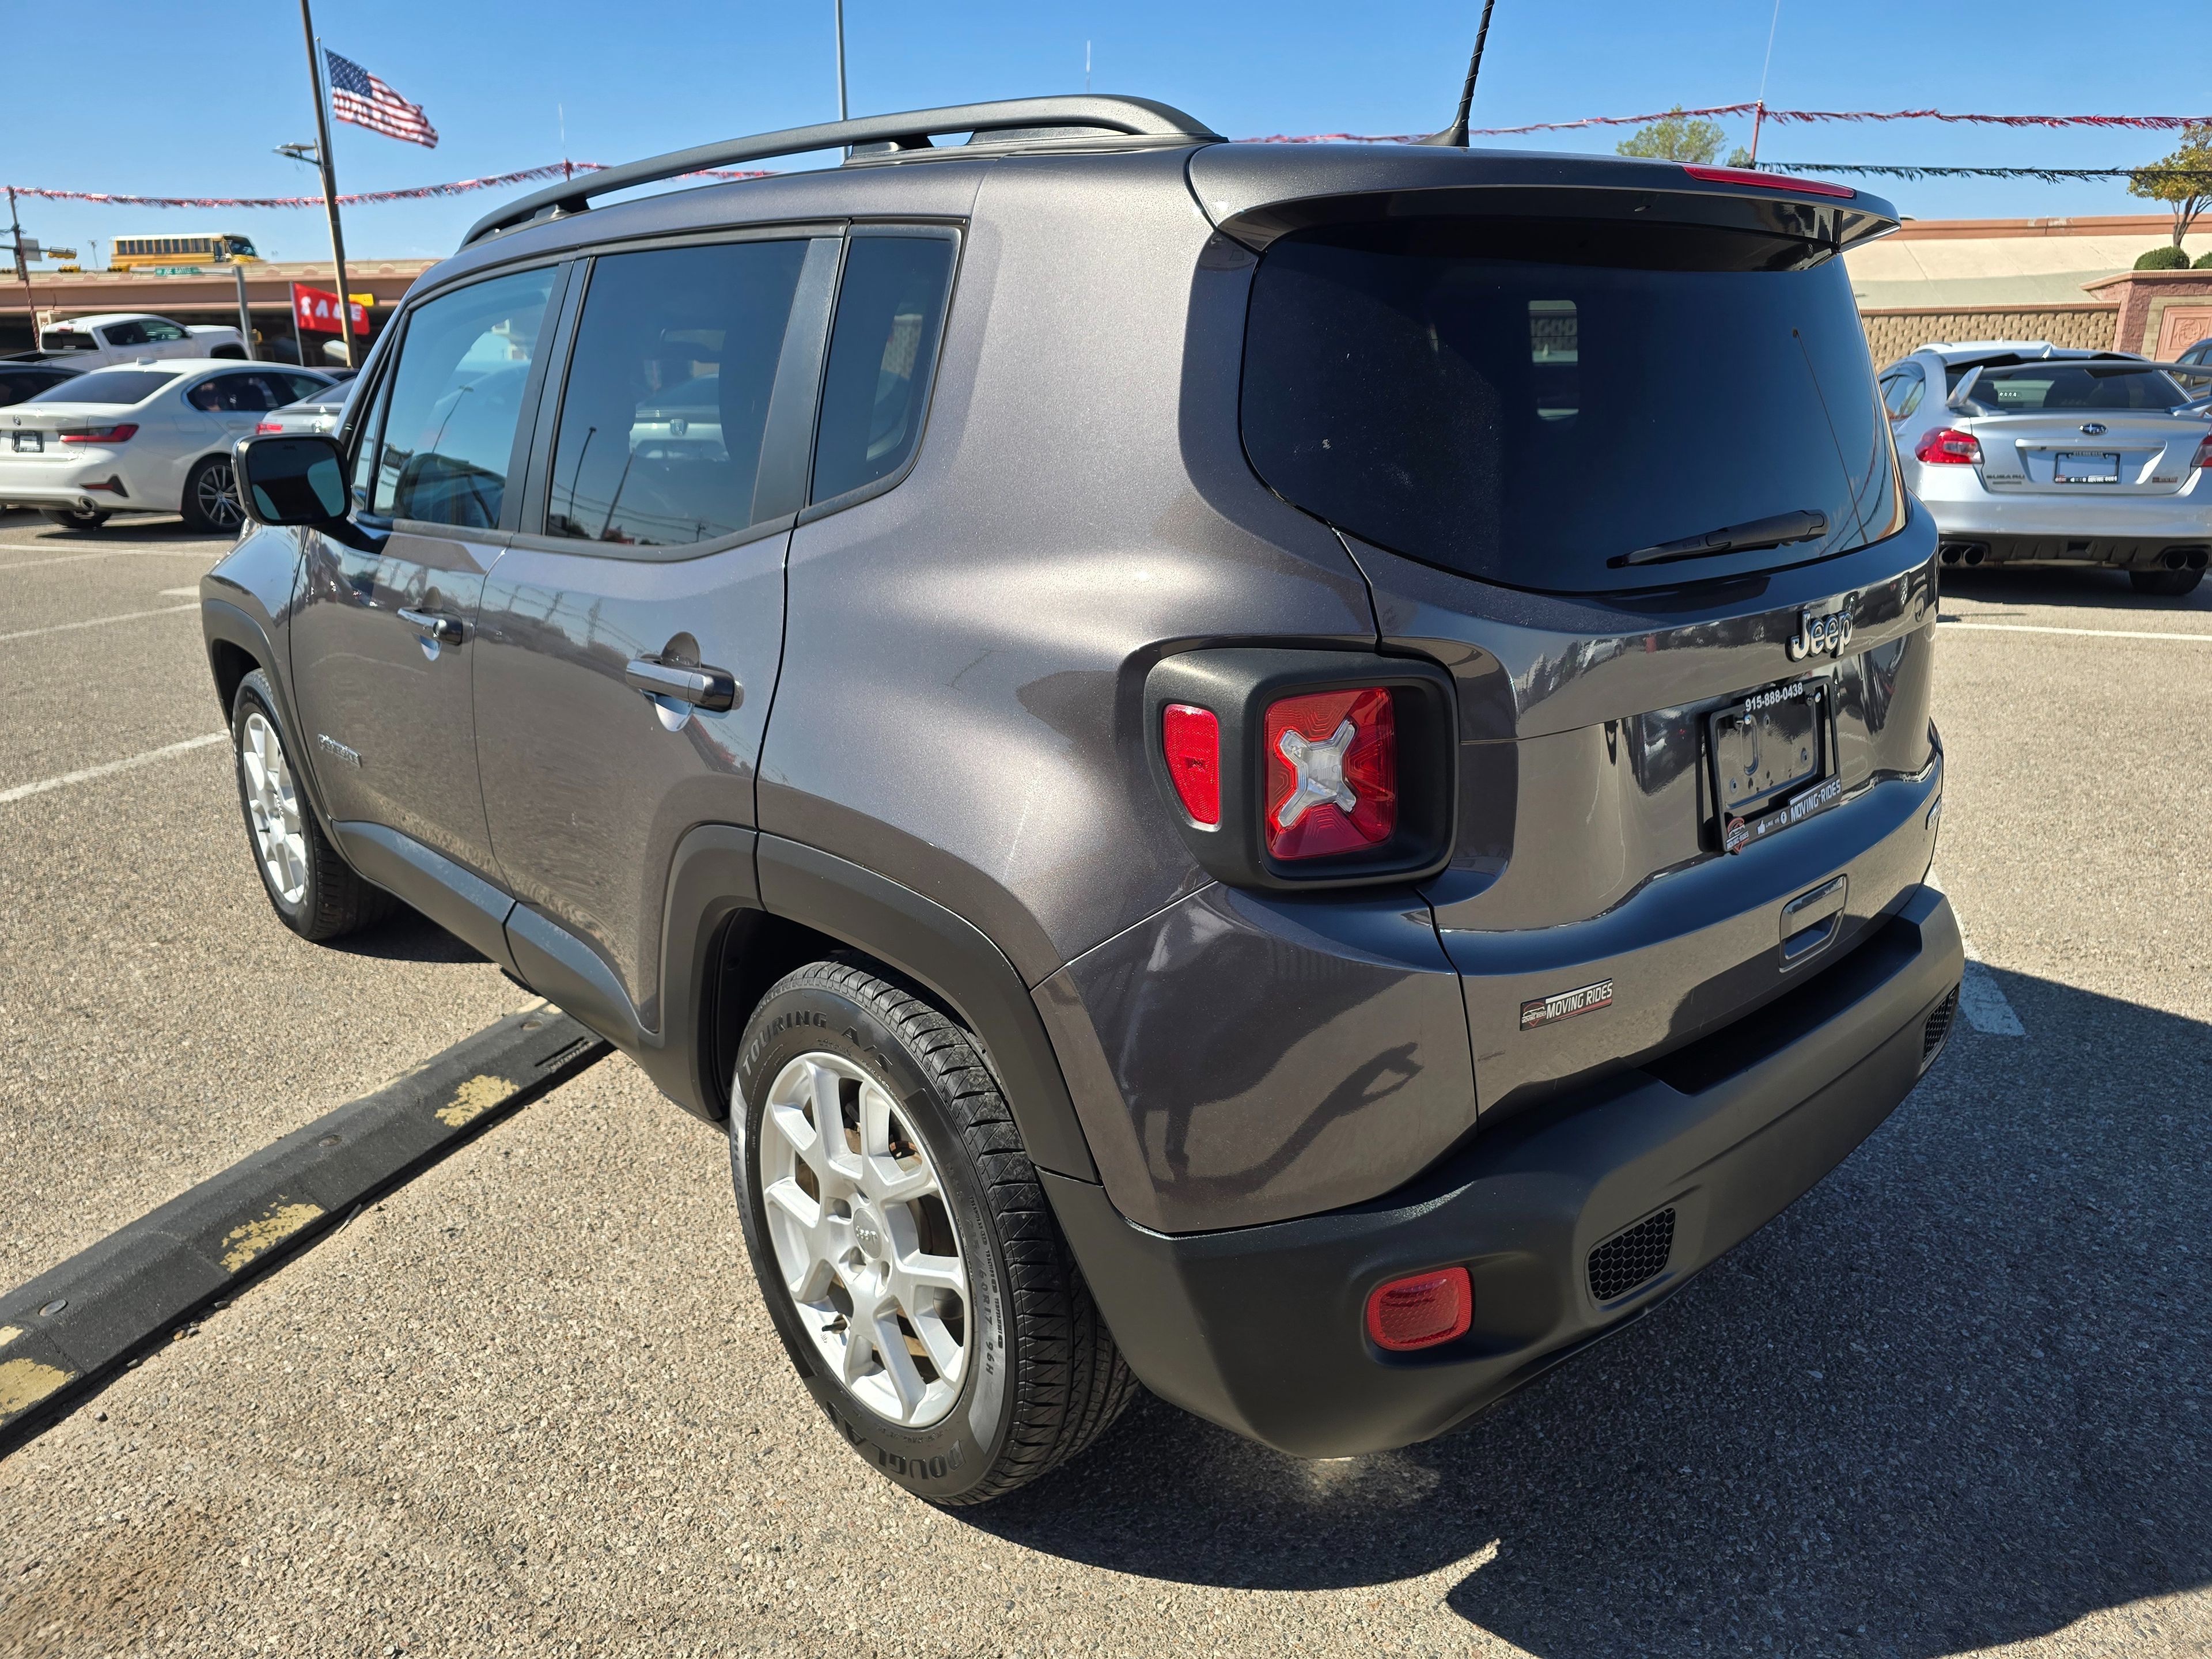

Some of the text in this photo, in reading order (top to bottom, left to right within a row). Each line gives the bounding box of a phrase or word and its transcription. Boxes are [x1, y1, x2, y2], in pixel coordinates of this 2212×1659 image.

[1788, 609, 1853, 662] Jeep
[1745, 682, 1804, 712] 915-888-0438
[1546, 982, 1613, 1019] MOVING RIDES
[743, 1010, 828, 1077] TOURING
[985, 1340, 995, 1376] 96H
